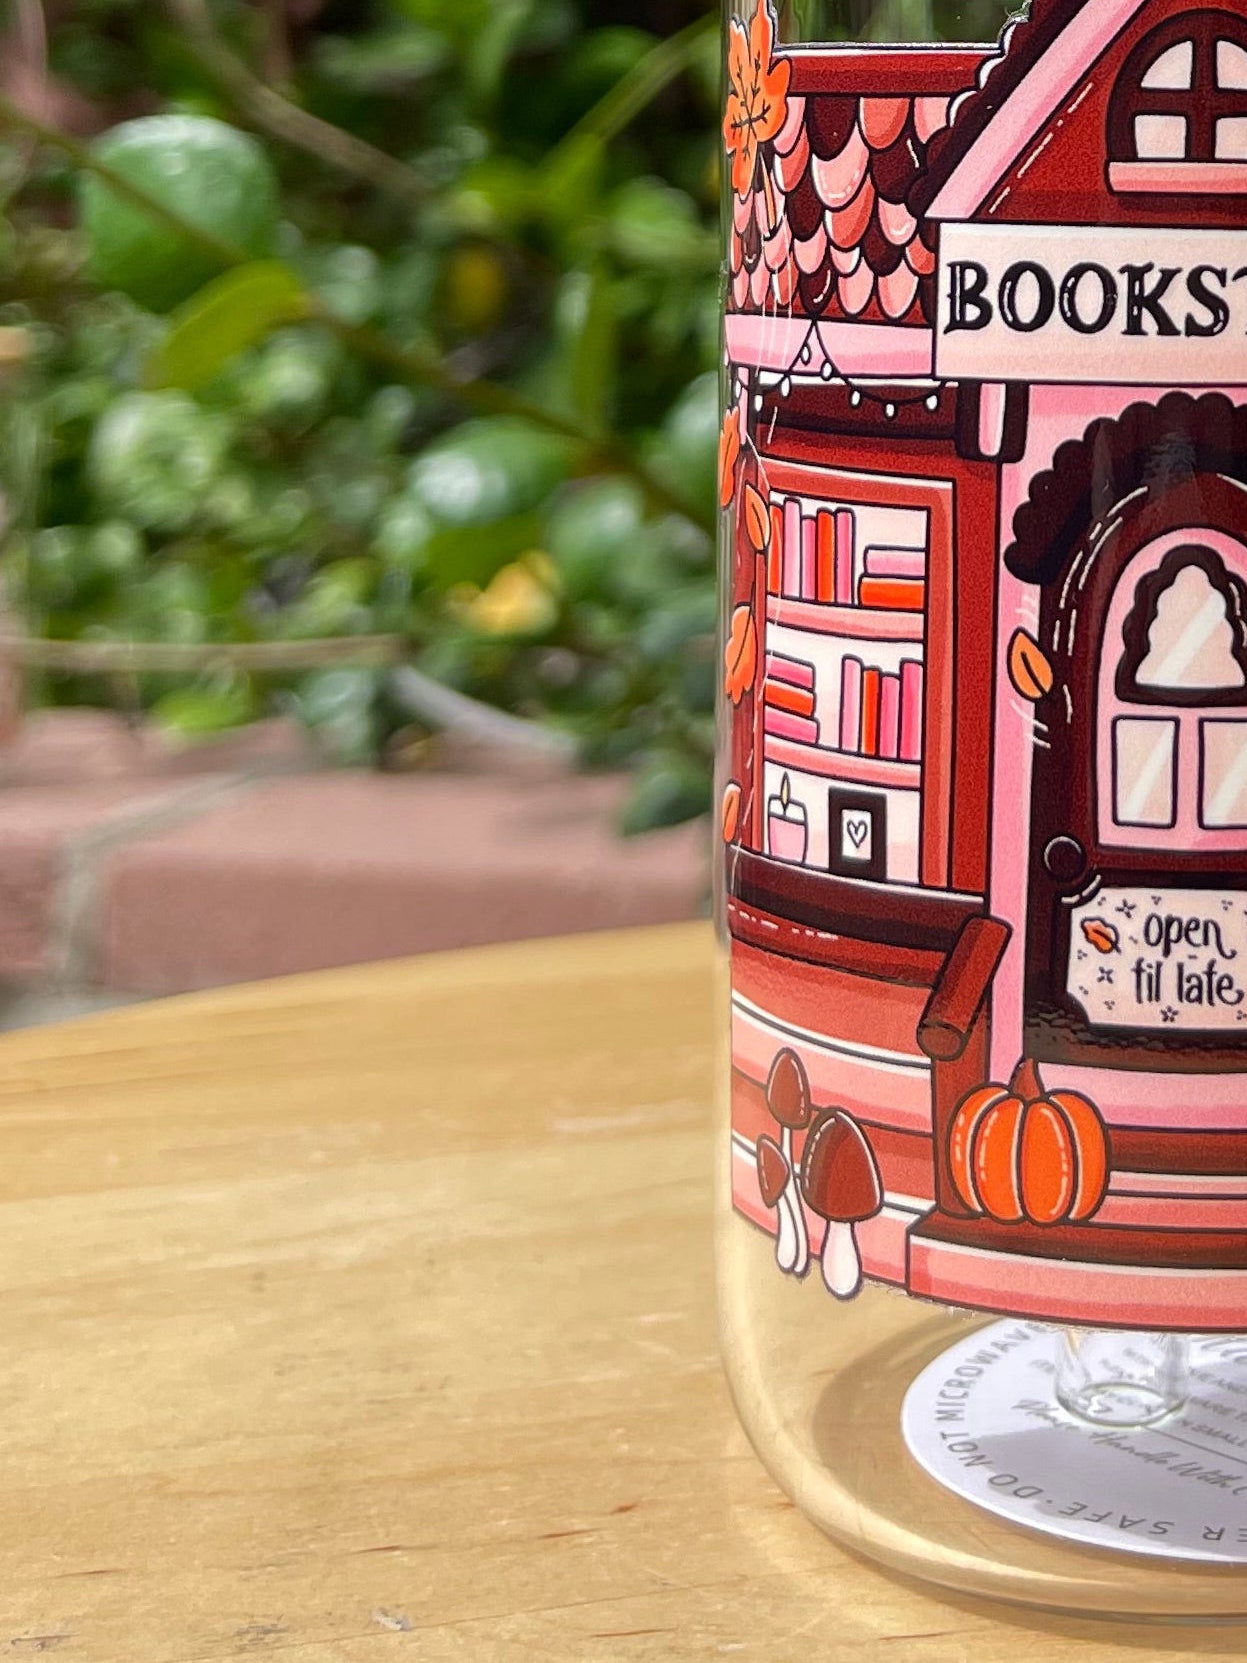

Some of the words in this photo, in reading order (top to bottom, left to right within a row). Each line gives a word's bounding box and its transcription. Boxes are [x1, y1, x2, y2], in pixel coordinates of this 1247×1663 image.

[1144, 913, 1237, 959] open
[1132, 957, 1163, 1004] til
[1177, 959, 1245, 1007] late
[940, 1432, 993, 1468] NOT
[1088, 1431, 1182, 1465] Handle
[1167, 1460, 1244, 1490] With
[988, 1473, 1044, 1500] DO
[1059, 1501, 1176, 1536] SAFE
